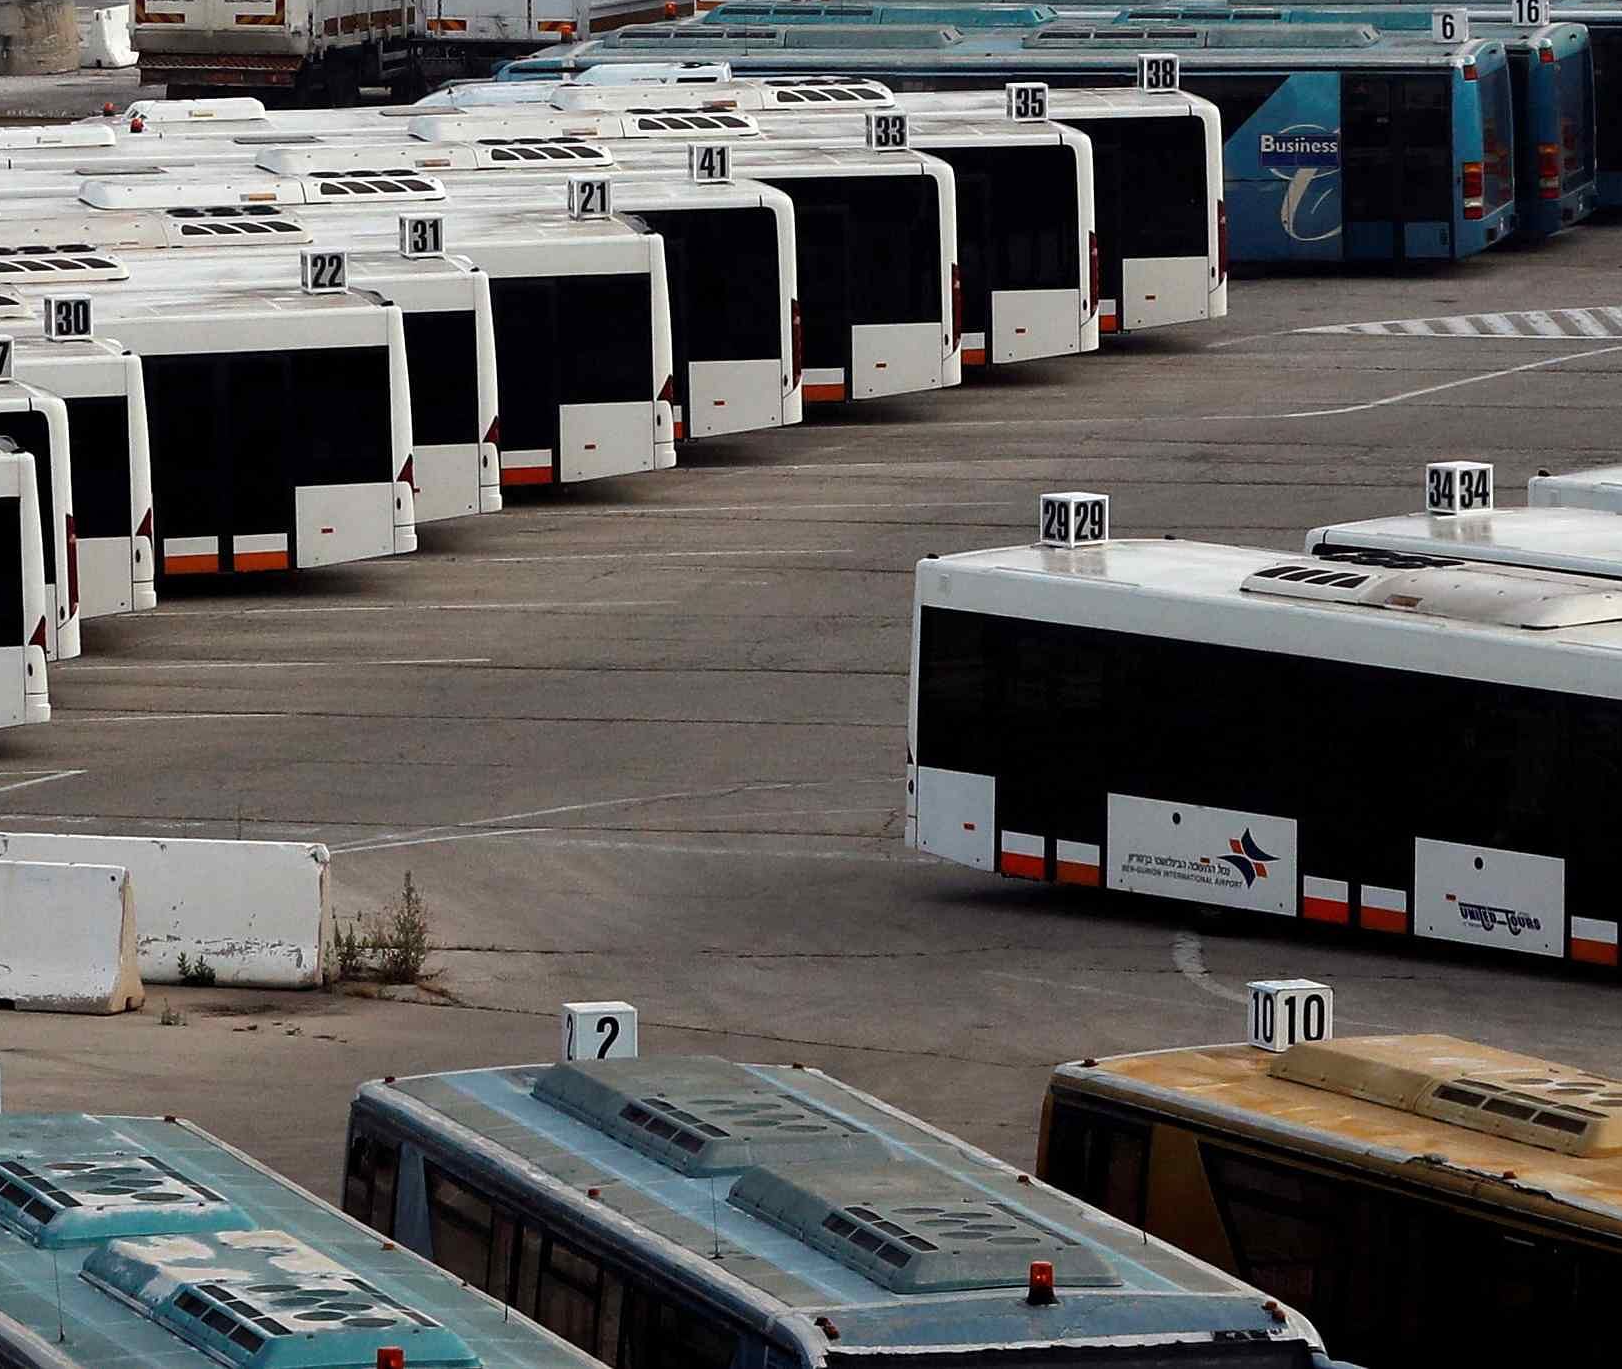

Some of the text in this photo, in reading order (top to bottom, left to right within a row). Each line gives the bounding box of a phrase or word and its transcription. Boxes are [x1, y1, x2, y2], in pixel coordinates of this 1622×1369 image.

[1441, 13, 1455, 40] 6
[1147, 59, 1175, 90] 38
[1016, 88, 1045, 118] 35
[877, 116, 905, 147] 33
[1260, 135, 1338, 153] Business
[700, 147, 727, 179] 41
[580, 181, 606, 213] 21
[413, 219, 440, 252] 31
[312, 255, 343, 287] 22
[57, 301, 90, 335] 30
[1428, 468, 1455, 509] 34
[1460, 469, 1489, 510] 34
[1044, 500, 1070, 541] 29
[1074, 502, 1104, 541] 29
[1252, 990, 1274, 1043] 10
[1284, 993, 1326, 1045] 10
[566, 1013, 574, 1061] 2
[596, 1016, 621, 1060] 2
